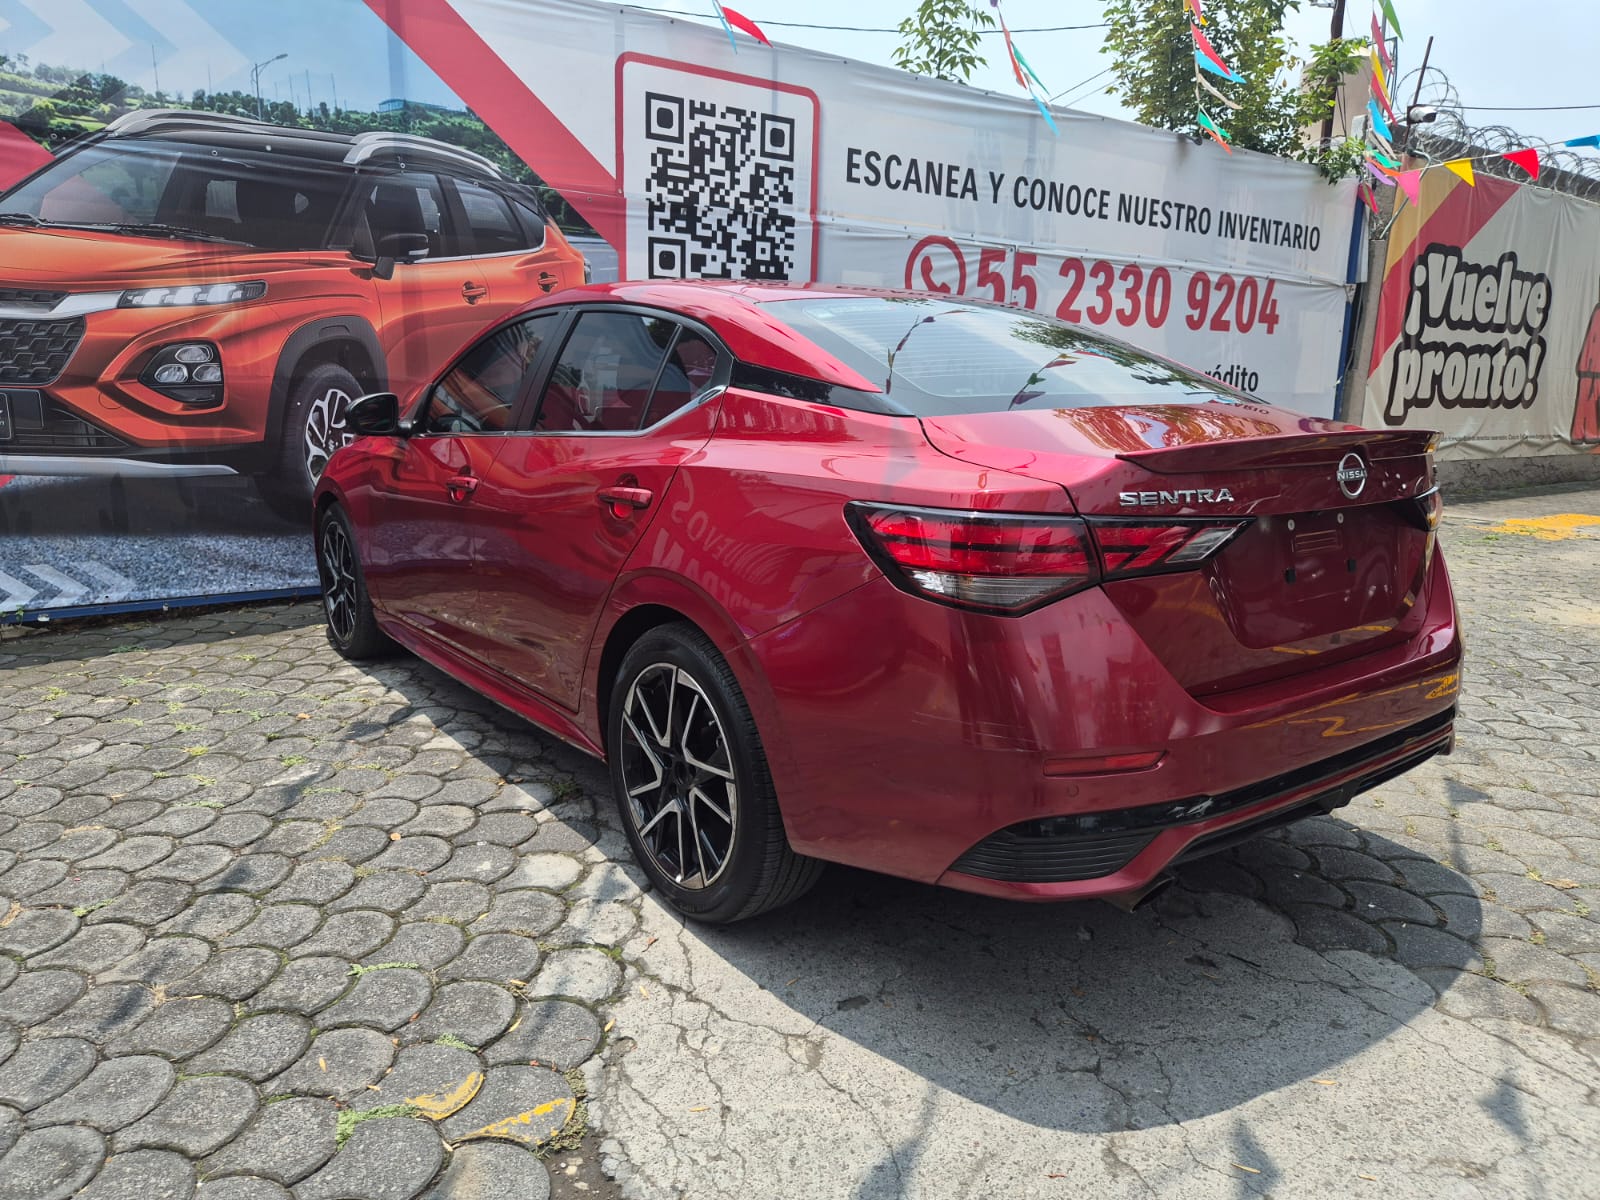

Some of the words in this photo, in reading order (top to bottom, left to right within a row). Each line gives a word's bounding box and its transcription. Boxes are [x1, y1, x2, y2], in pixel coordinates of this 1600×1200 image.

[846, 147, 978, 201] ESCANEA
[988, 171, 1005, 204] Y
[1013, 176, 1111, 220] CONOCE
[1117, 193, 1211, 235] NUESTRO
[1217, 210, 1321, 252] INVENTARIO
[977, 248, 1037, 310] 55
[1055, 257, 1172, 329] 2330
[1185, 271, 1280, 335] 9204
[1403, 247, 1549, 339] ¡Vuelve
[1387, 340, 1544, 420] pronto!
[1119, 488, 1235, 506] SENTRA
